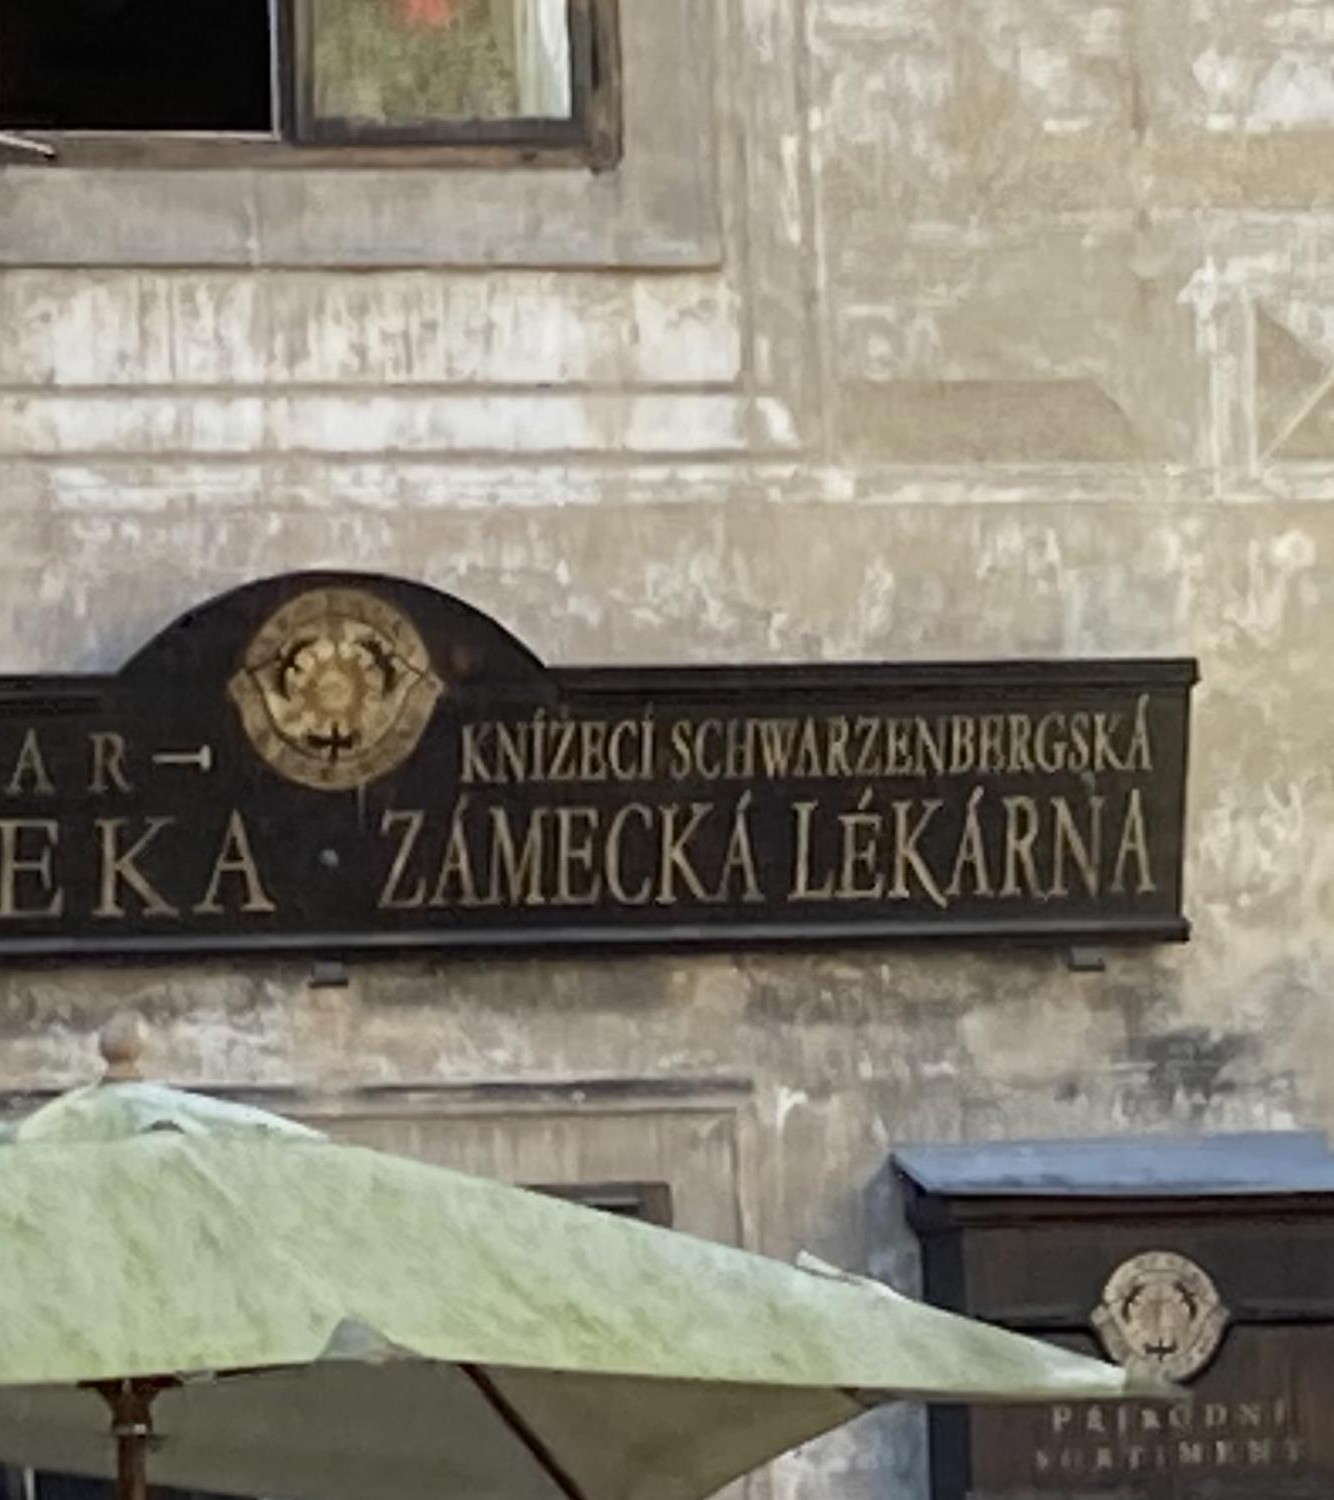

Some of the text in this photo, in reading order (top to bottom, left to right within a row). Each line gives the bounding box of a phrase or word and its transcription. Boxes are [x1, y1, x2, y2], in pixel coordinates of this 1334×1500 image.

[671, 693, 1154, 782] SCHWARZENBERGSKÁ
[379, 785, 1156, 910] ZÁMECKÁ LÉKÁRNA
